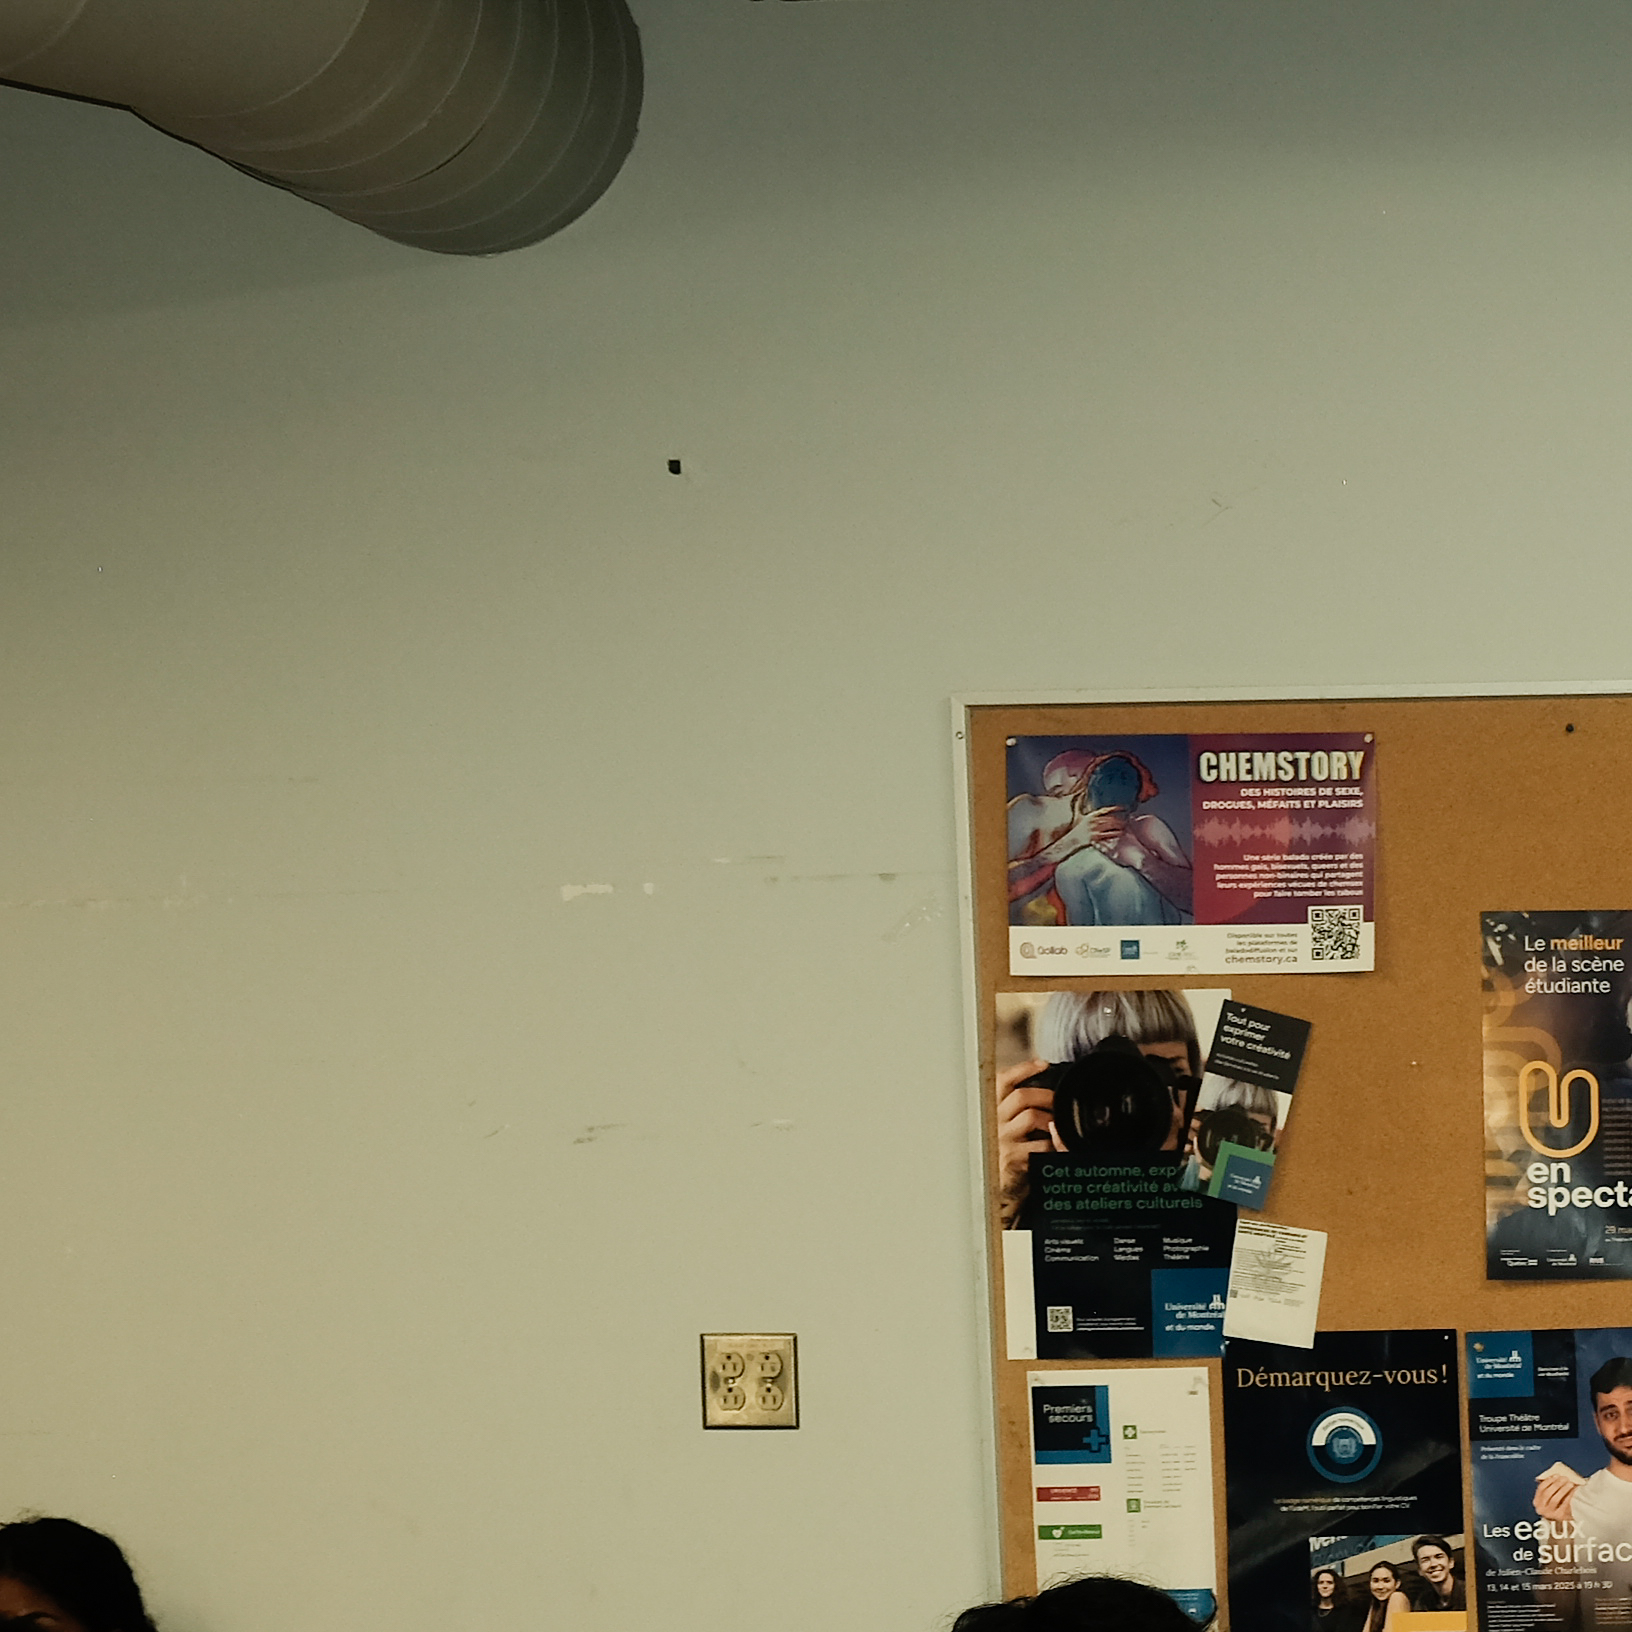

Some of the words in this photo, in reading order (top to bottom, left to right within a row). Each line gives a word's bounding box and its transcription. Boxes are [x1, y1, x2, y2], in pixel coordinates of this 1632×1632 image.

[1200, 751, 1364, 782] CHEMSTORY
[1264, 788, 1316, 796] HISTOIRES
[1319, 788, 1332, 796] DE
[1335, 787, 1363, 796] SEXE,
[1203, 801, 1255, 810] DROGUES,
[1258, 799, 1301, 809] MÉFAITS
[1318, 800, 1363, 808] PLAISIRS
[1524, 936, 1546, 951] Le
[1550, 934, 1624, 951] meilleur
[1225, 955, 1297, 965] chemstory.ca
[1524, 957, 1547, 973] de
[1552, 957, 1567, 972] la
[1571, 957, 1625, 972] scène
[1525, 978, 1611, 994] étudiante
[1226, 1012, 1247, 1026] Tout
[1247, 1020, 1271, 1032] pour
[1223, 1025, 1266, 1042] exprimer
[1220, 1035, 1245, 1047] votre
[1245, 1042, 1291, 1060] créativité
[1042, 1165, 1069, 1177] Cet
[1074, 1166, 1145, 1179] automne,
[1527, 1162, 1571, 1183] en
[1043, 1182, 1086, 1193] votre
[1090, 1179, 1158, 1193] créativité
[1044, 1199, 1072, 1210] des
[1076, 1197, 1132, 1210] ateliers
[1137, 1196, 1203, 1209] culturels
[1043, 1404, 1093, 1414] Premiers
[1049, 1414, 1093, 1423] secours
[1479, 1414, 1507, 1423] Troupe
[1509, 1414, 1540, 1422] Théâtre
[1479, 1425, 1520, 1433] Université
[1534, 1422, 1569, 1431] Montréal
[1483, 1524, 1510, 1537] Les
[1514, 1519, 1585, 1541] eaux
[1513, 1548, 1534, 1562] de
[1487, 1584, 1498, 1592] 13,
[1500, 1583, 1509, 1591] 14
[1511, 1583, 1519, 1591] et
[1522, 1583, 1531, 1591] 15
[1554, 1582, 1575, 1590] 2025
